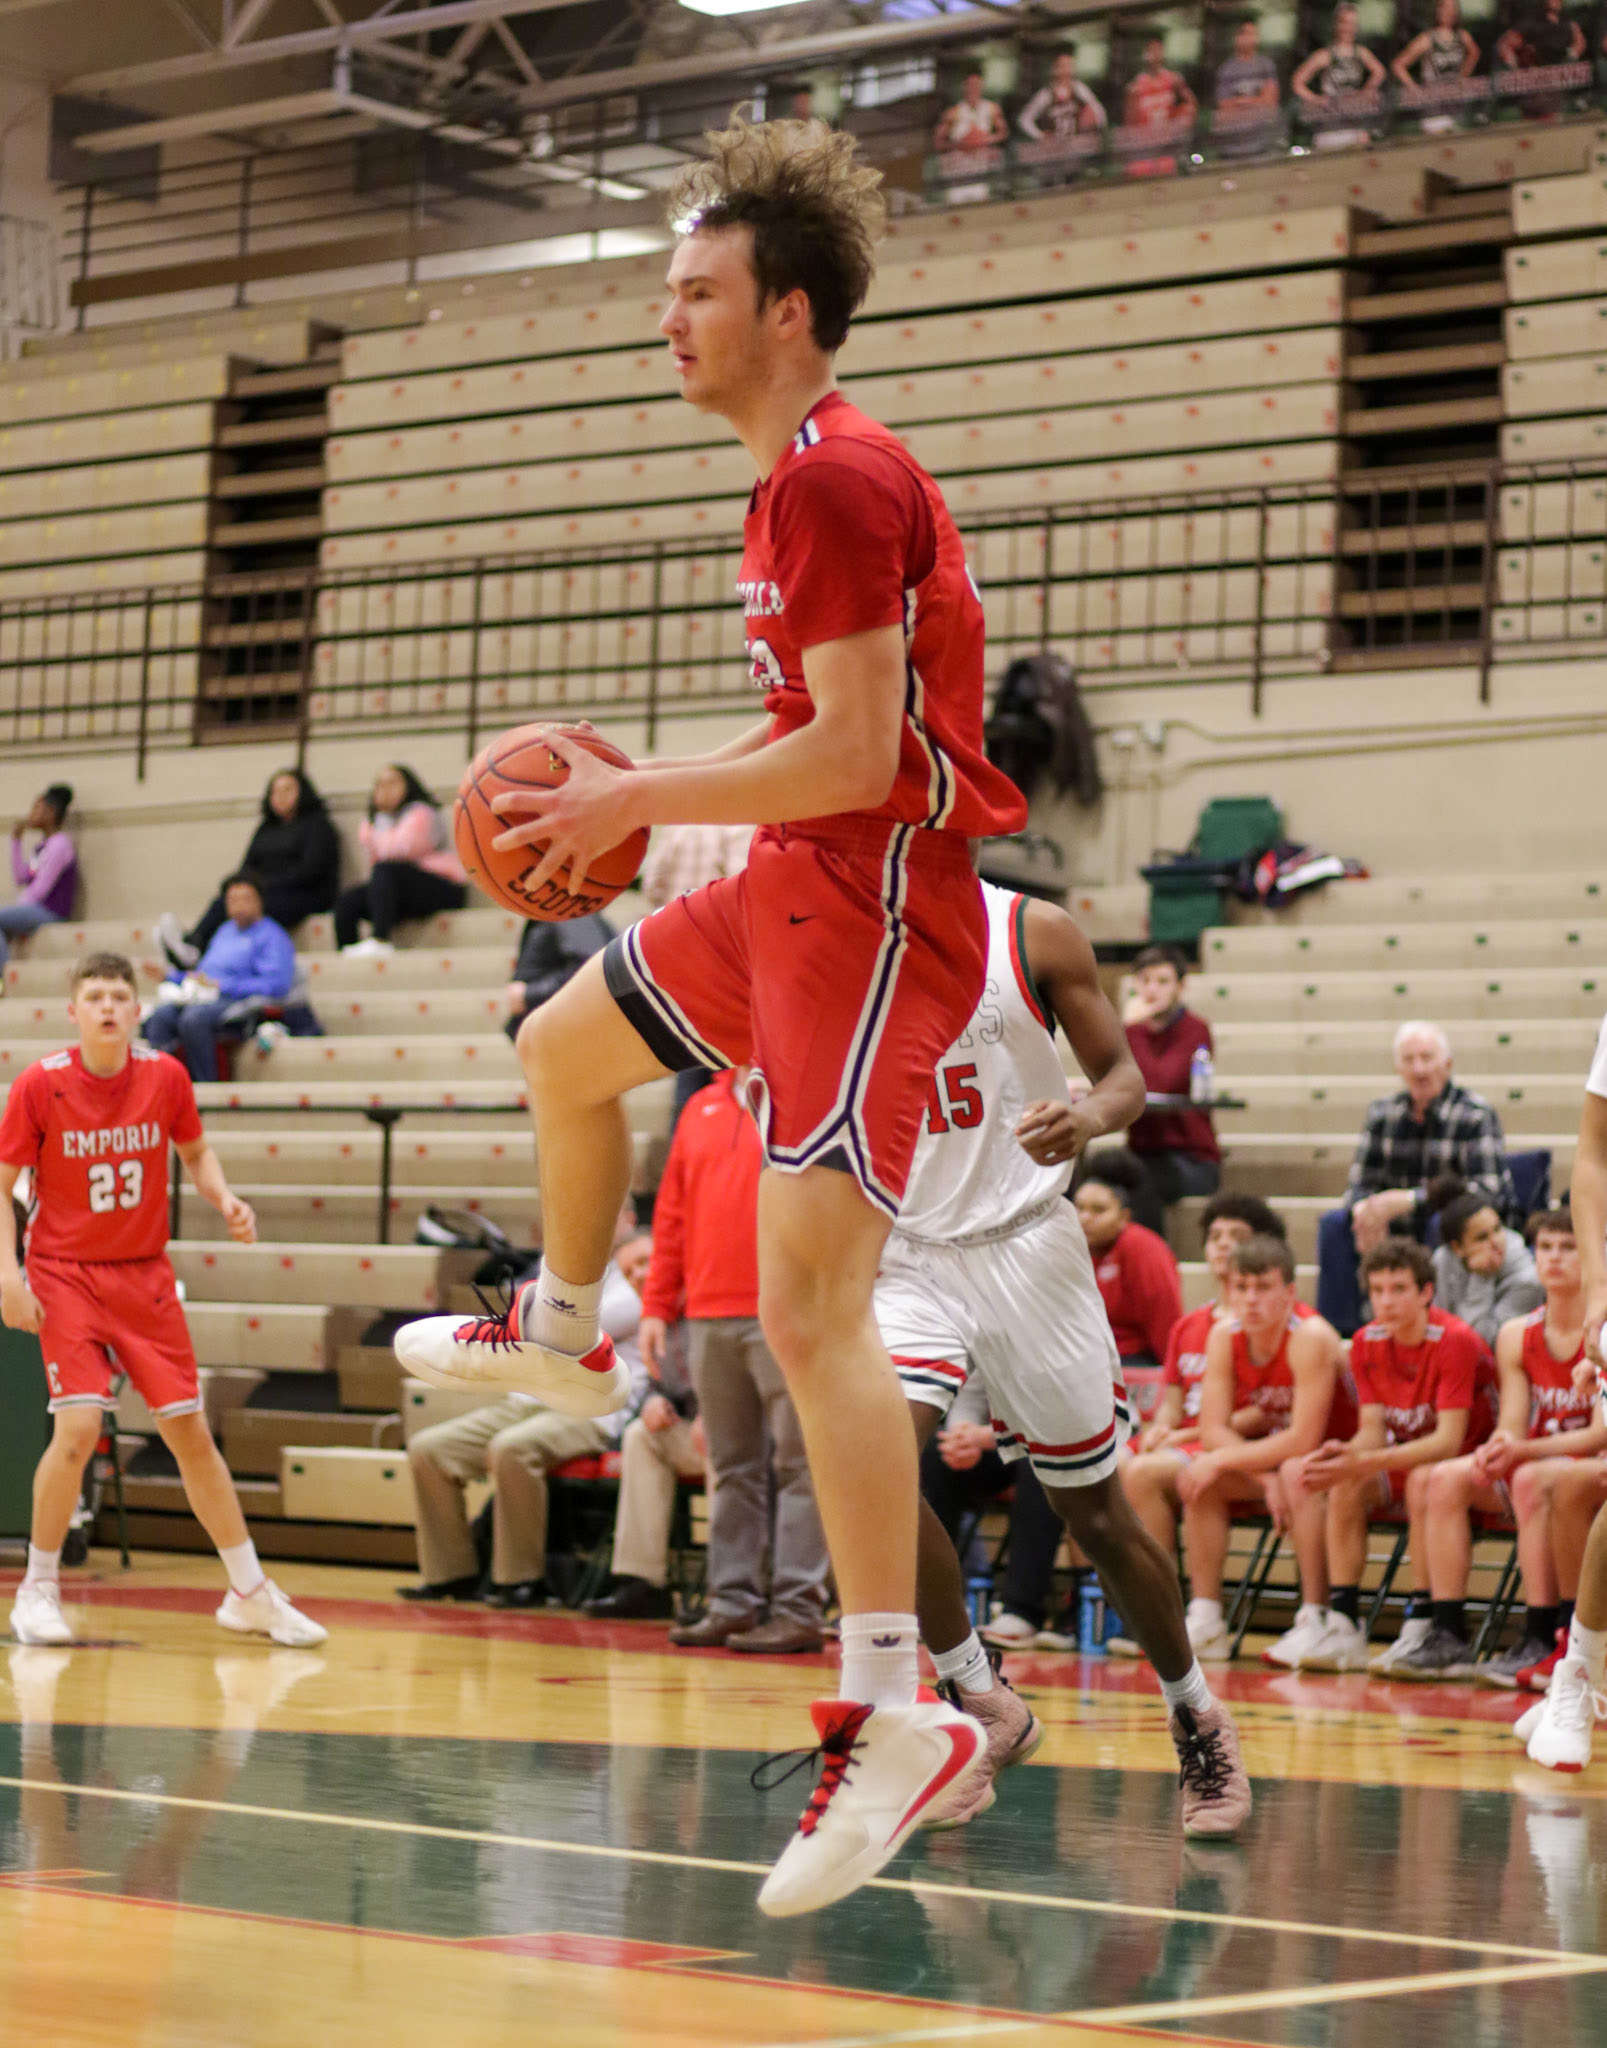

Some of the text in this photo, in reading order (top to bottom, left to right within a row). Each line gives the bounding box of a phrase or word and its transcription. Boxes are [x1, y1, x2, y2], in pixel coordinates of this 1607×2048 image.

[927, 1062, 985, 1135] 15
[62, 1120, 160, 1158] EMPORIA
[88, 1158, 143, 1213] 23
